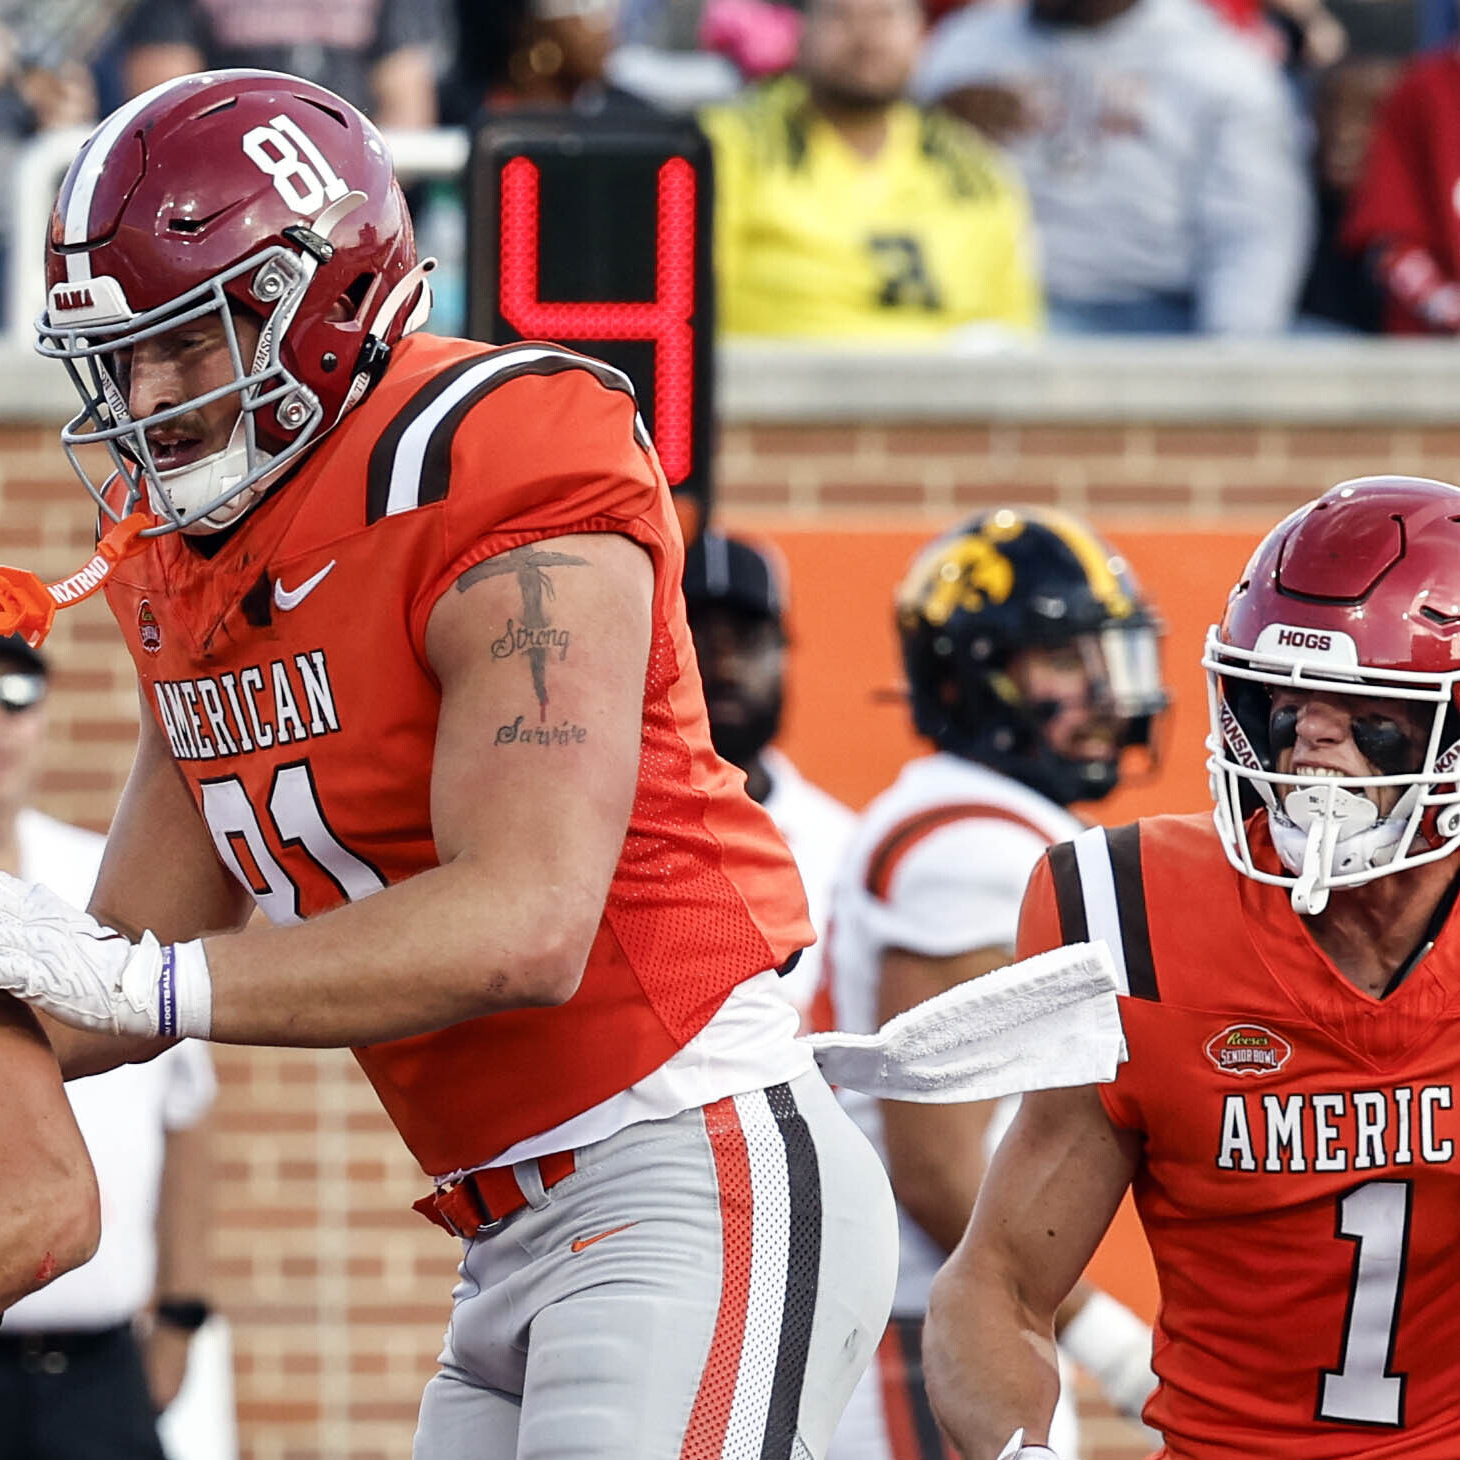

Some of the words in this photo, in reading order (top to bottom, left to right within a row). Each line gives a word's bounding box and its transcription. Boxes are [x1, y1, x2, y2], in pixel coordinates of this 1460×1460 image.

[242, 114, 348, 217] 81
[53, 288, 95, 311] BAMA
[499, 156, 695, 486] 4
[46, 555, 110, 604] NXTRND
[491, 618, 570, 662] Strong
[1278, 629, 1332, 652] HOGS
[153, 648, 342, 761] AMERICAN
[1219, 701, 1261, 772] KANSAS
[163, 968, 172, 1026] FOOTBALL
[1220, 1049, 1252, 1066] SENIOR
[1253, 1048, 1278, 1067] BOWL
[1216, 1085, 1455, 1174] AMERIC
[1314, 1178, 1414, 1428] 1
